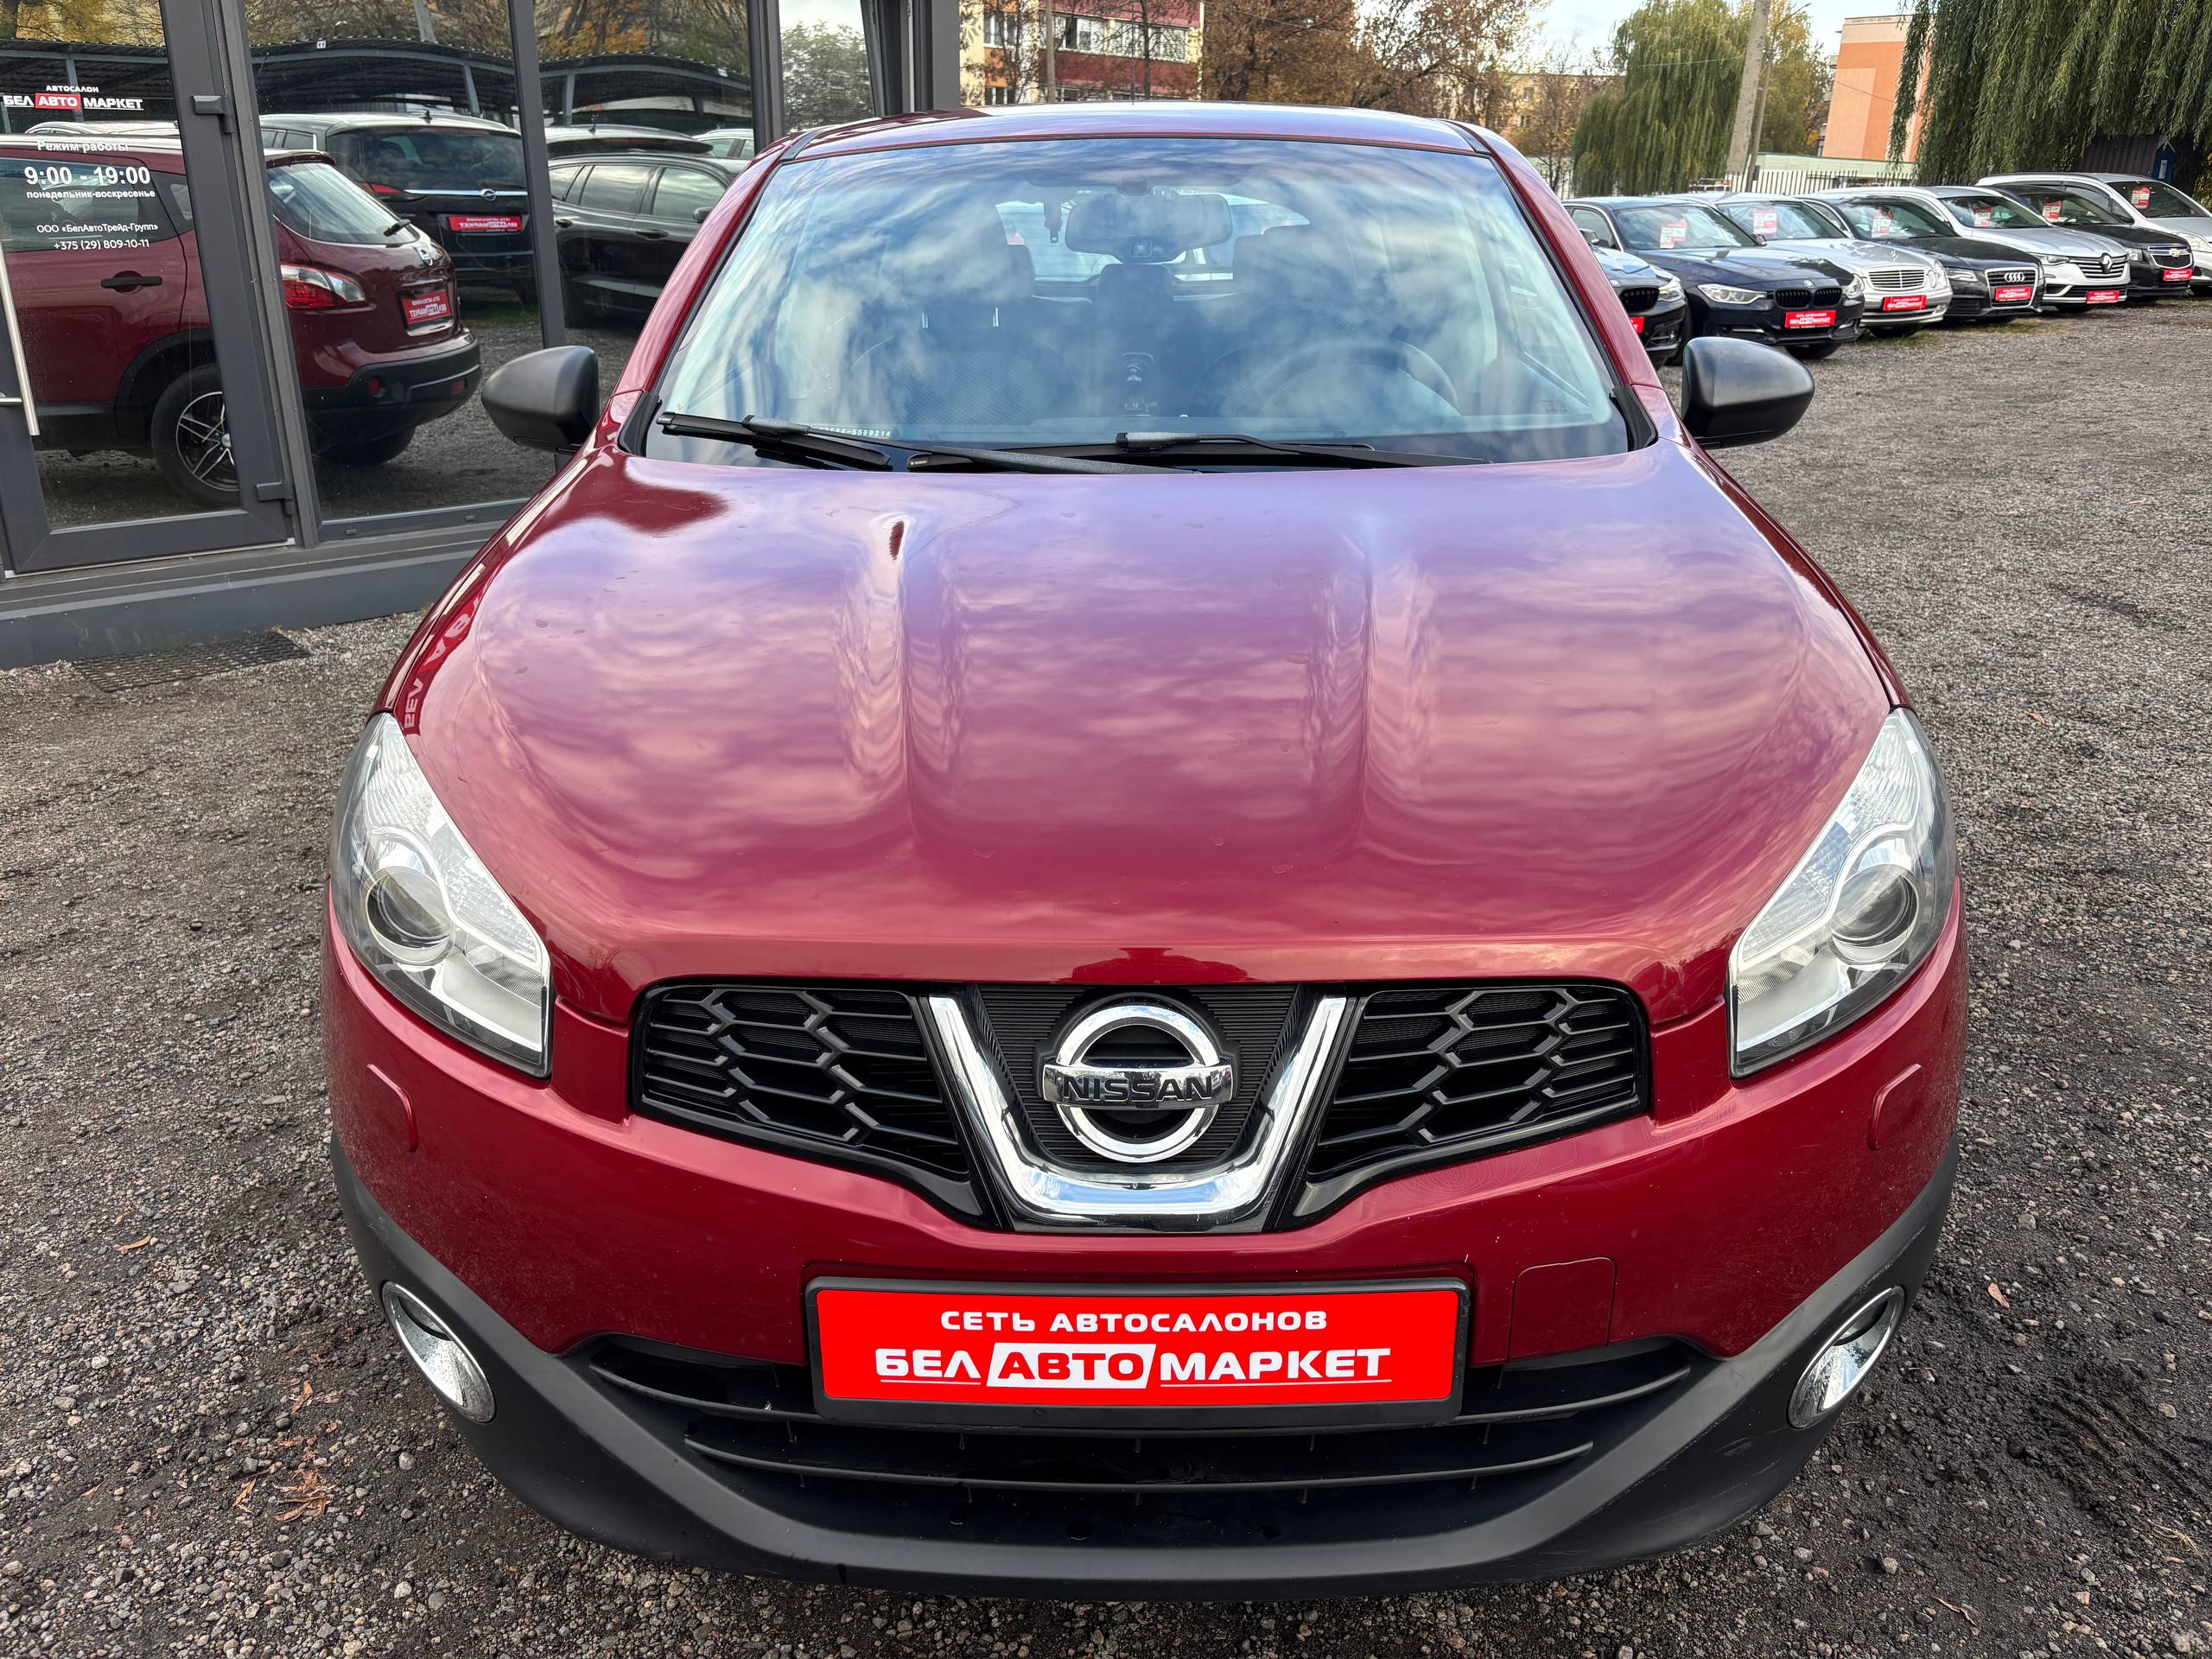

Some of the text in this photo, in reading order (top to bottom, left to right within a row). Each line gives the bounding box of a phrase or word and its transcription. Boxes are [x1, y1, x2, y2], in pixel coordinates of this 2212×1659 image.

[46, 85, 99, 93] АВТОСАЛОН
[37, 140, 129, 154] Режим работы
[24, 166, 73, 185] 9:00
[93, 166, 150, 185] 19:00
[26, 189, 156, 200] понедельник-воскресенье
[36, 225, 60, 233] ООО
[54, 239, 149, 251] +375 (29) 809-10-11
[1063, 1075, 1213, 1103] NISSAN
[940, 1311, 1327, 1333] СЕТЬ АВТОСАЛОНОВ
